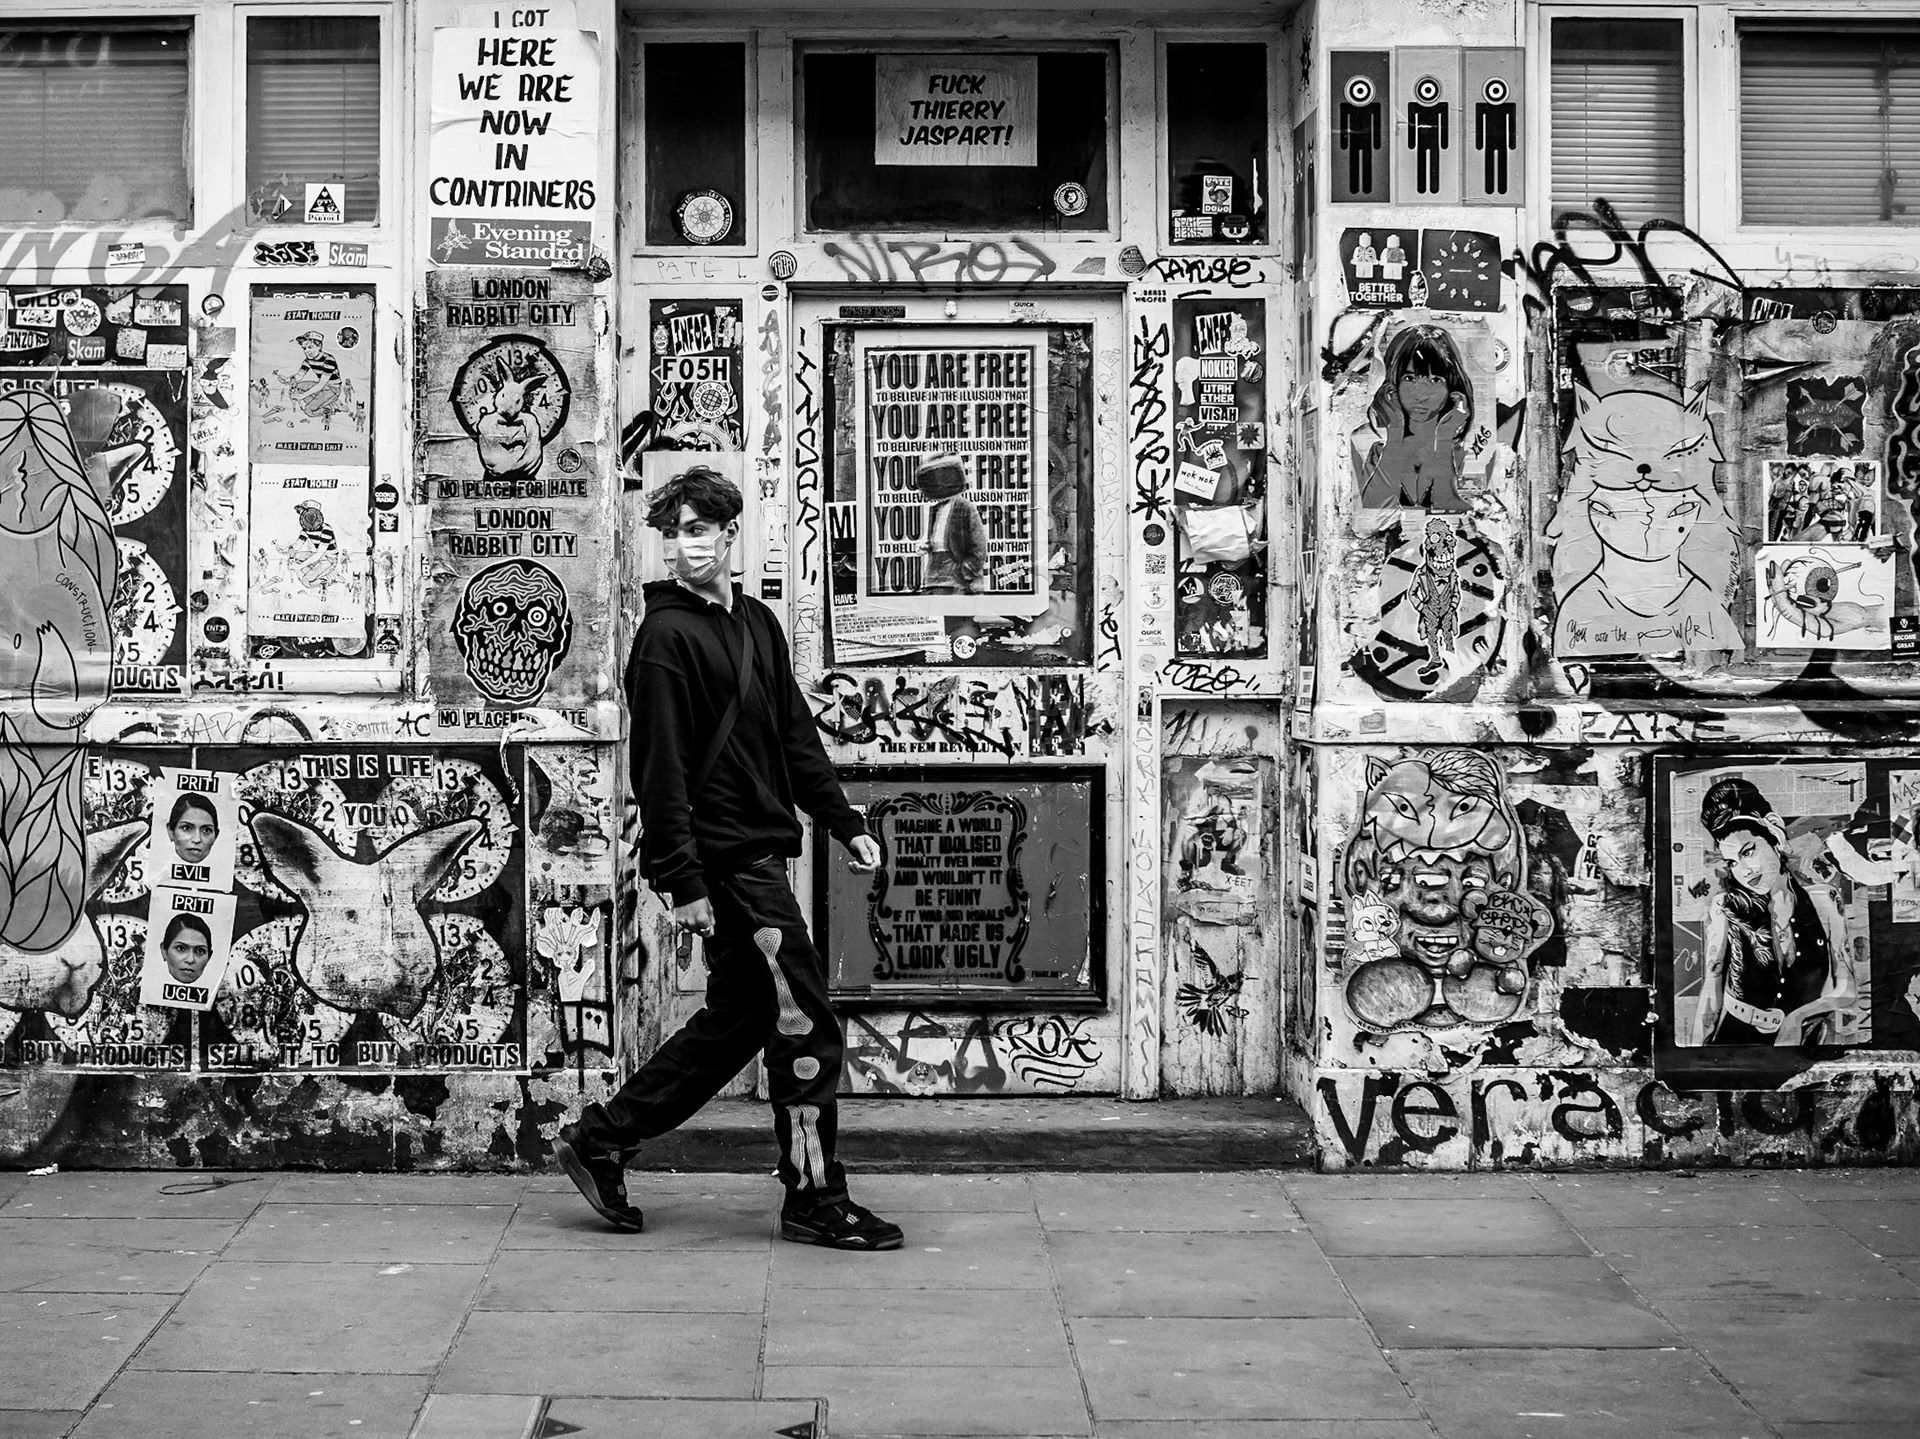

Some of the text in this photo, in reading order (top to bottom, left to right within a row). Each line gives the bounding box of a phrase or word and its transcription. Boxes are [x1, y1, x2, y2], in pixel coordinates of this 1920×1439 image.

[494, 9, 550, 28] I GOT
[477, 37, 557, 67] HERE
[458, 73, 574, 102] WE ARE
[929, 75, 986, 94] FUCK
[909, 100, 1006, 119] THIERRY
[479, 110, 551, 135] NOW
[900, 125, 1014, 146] JASPART!
[495, 143, 528, 170] IN
[429, 177, 595, 210] CONTAINERS
[1205, 204, 1229, 212] DODO
[472, 222, 573, 247] Evening
[329, 244, 367, 266] Skam
[485, 241, 584, 261] Standrd
[474, 279, 549, 299] LONDON
[1350, 291, 1403, 303] TOGETHER
[1358, 282, 1396, 292] BETTER
[286, 310, 341, 320] STAY HOME!
[449, 305, 574, 326] RABBIT CITY
[68, 338, 106, 359] Skam
[508, 350, 523, 366] 13
[872, 352, 1028, 389] YOU ARE FREE
[1201, 359, 1236, 379] NOKIER
[474, 378, 488, 396] 10
[876, 390, 1028, 402] TO BELIEVE IN THE ILLUSION THAT
[1203, 384, 1232, 393] UTAH
[1202, 394, 1234, 403] ETHER
[872, 403, 1028, 440] YOU ARE FREE
[1201, 407, 1237, 421] VISAH
[877, 441, 1028, 452] TO BELIEVE IN THE ILLUSION THAT
[873, 455, 1029, 491] YOU FREE
[284, 479, 338, 488] STAY HOME!
[440, 479, 586, 497] NO PLACE FOR HATE
[878, 493, 890, 503] TO
[1006, 492, 1029, 502] THAT
[476, 509, 551, 530] LONDON
[874, 505, 922, 540] YOU
[451, 534, 576, 556] RABBIT CITY
[879, 543, 891, 553] TO
[1006, 542, 1029, 552] THAT
[875, 556, 922, 592] YOU
[274, 614, 295, 622] MAKE
[322, 615, 339, 623] SHIT
[1567, 619, 1588, 649] You
[1611, 625, 1627, 642] the
[113, 667, 178, 689] DUCTS
[440, 710, 510, 727] NO PLACE
[879, 742, 1022, 753] THE FEM REVLUTN
[303, 757, 431, 777] THIS IS LIFE
[106, 770, 126, 792] 13
[179, 776, 217, 792] PRITI
[280, 768, 300, 790] 13
[437, 768, 458, 790] 13
[344, 804, 386, 828] YOU
[895, 818, 1002, 834] IMAGINE A WORLD
[894, 835, 1001, 854] THAT IDOLISED
[945, 856, 969, 868] OVER
[173, 866, 209, 880] EVIL
[894, 870, 1002, 886] AND WOULDN'T IT
[174, 896, 213, 913] PRITI
[916, 888, 981, 906] BE FUNNY
[906, 910, 916, 922] IT
[107, 926, 127, 947] 13
[441, 924, 461, 947] 13
[893, 924, 1004, 942] THAT MADE US
[898, 945, 1000, 969] LOOK UGLY
[235, 965, 255, 989] 10
[165, 985, 208, 1002] UGLY
[24, 1041, 185, 1067] BUY PRODUCTS
[281, 1045, 299, 1065] IT
[313, 1044, 339, 1064] TO
[359, 1043, 396, 1064] BUY
[414, 1044, 519, 1066] PRODUCTS
